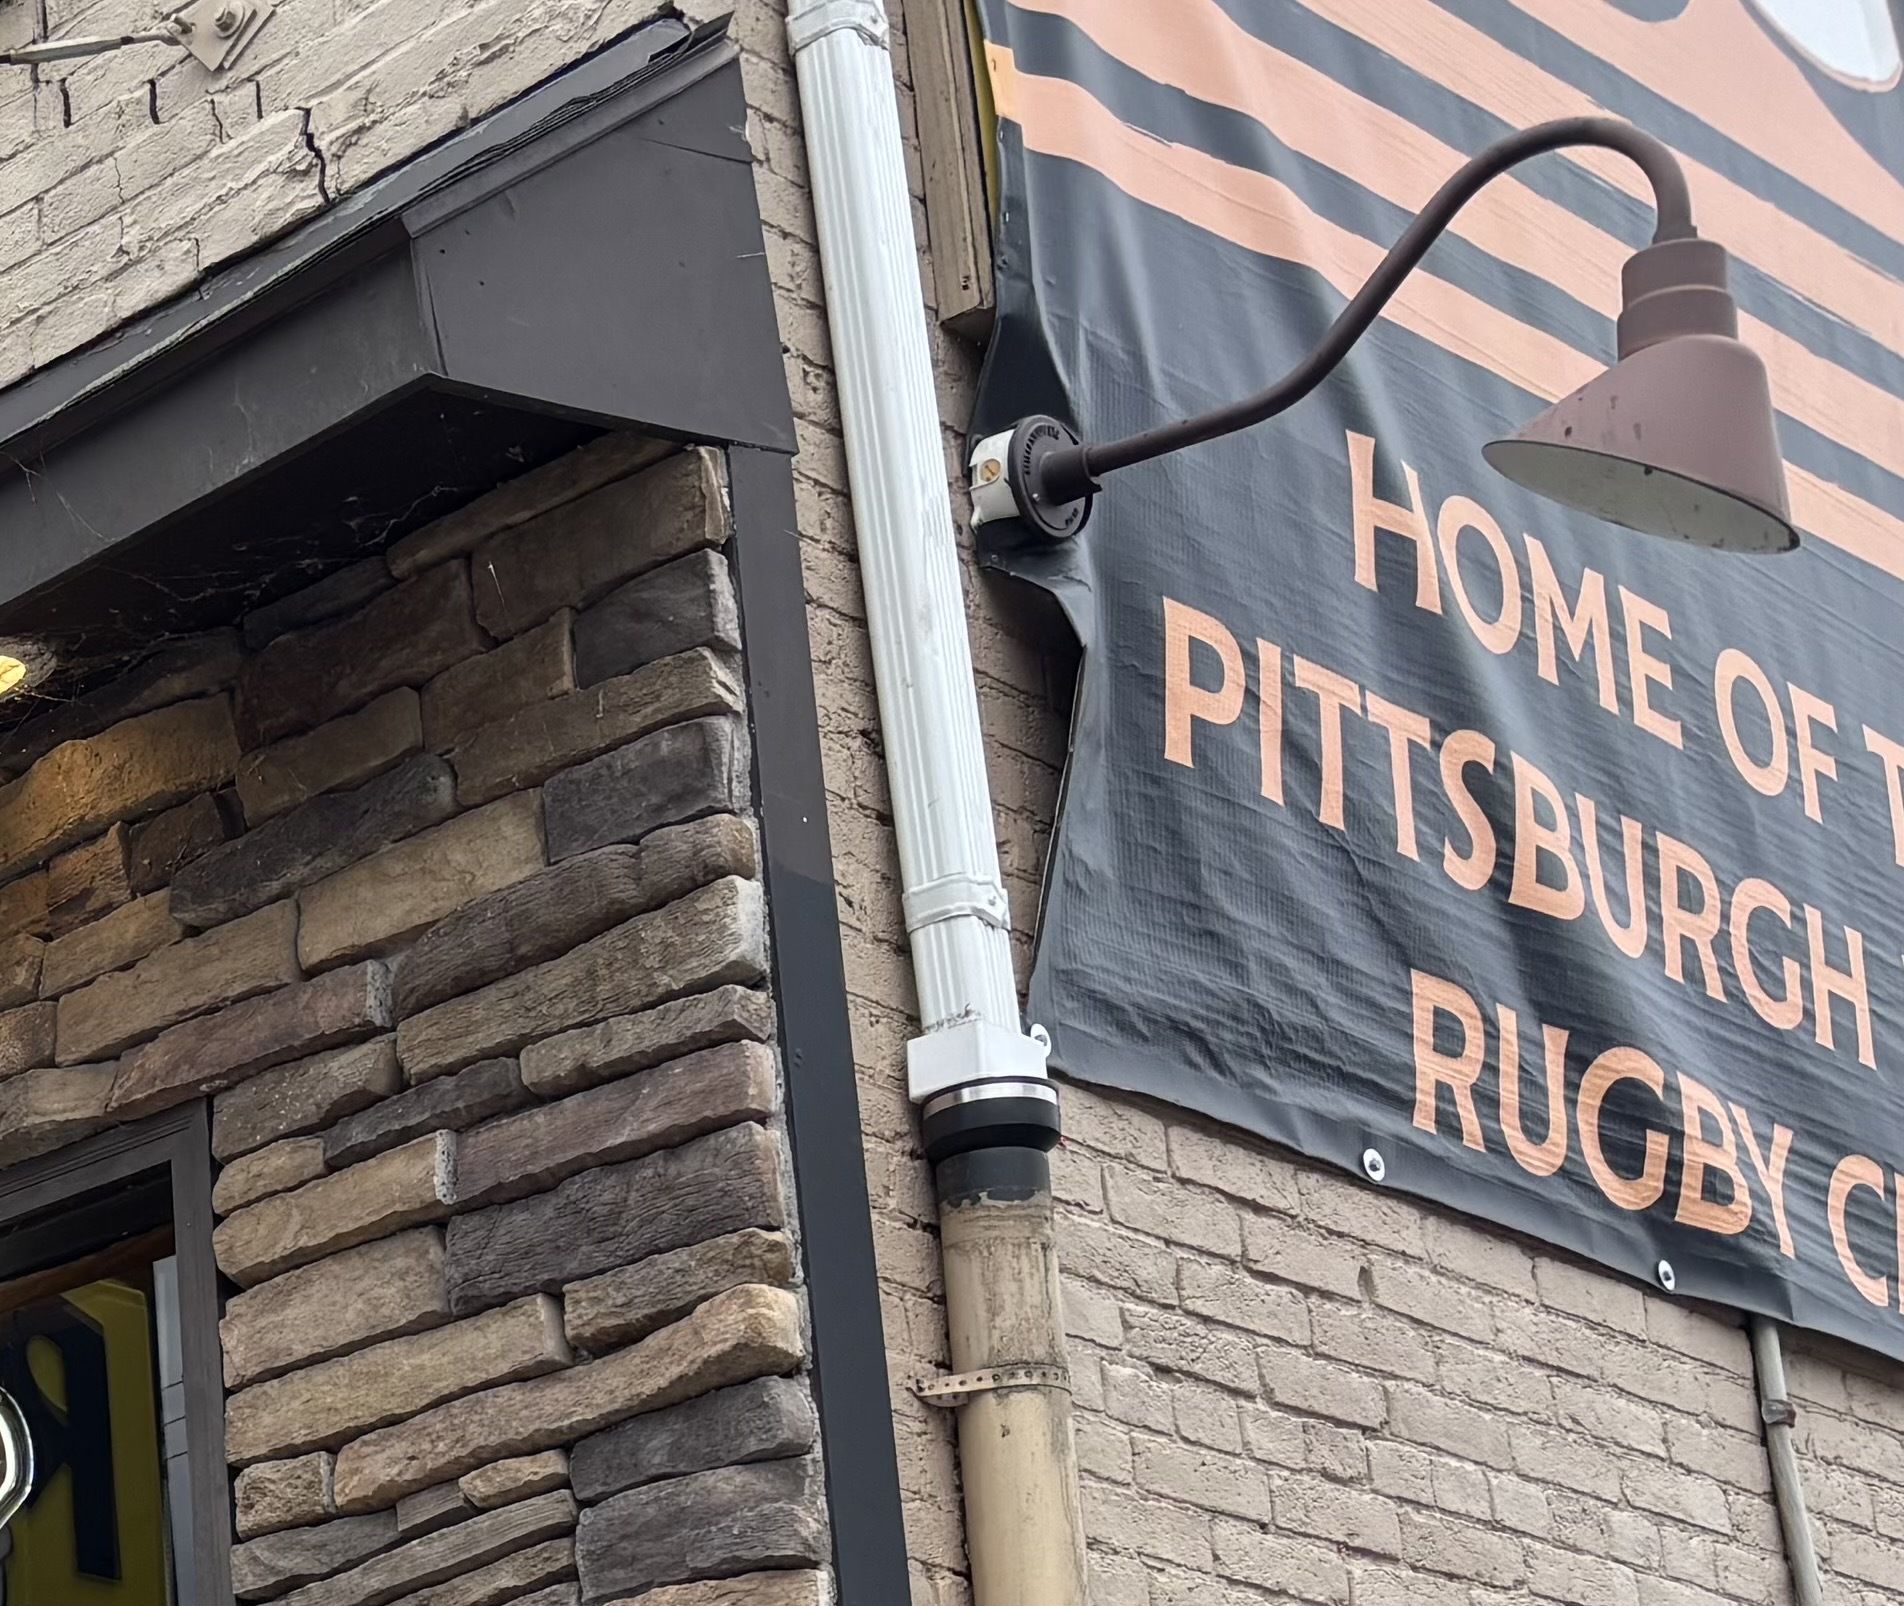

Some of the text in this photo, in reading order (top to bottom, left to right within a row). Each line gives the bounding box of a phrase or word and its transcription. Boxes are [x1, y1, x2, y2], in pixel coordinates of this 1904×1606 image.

[1345, 429, 1684, 749] HOME
[1714, 648, 1839, 824] OF
[1162, 594, 1877, 1069] PITTSBURGH
[1409, 968, 1795, 1260] RUGBY
